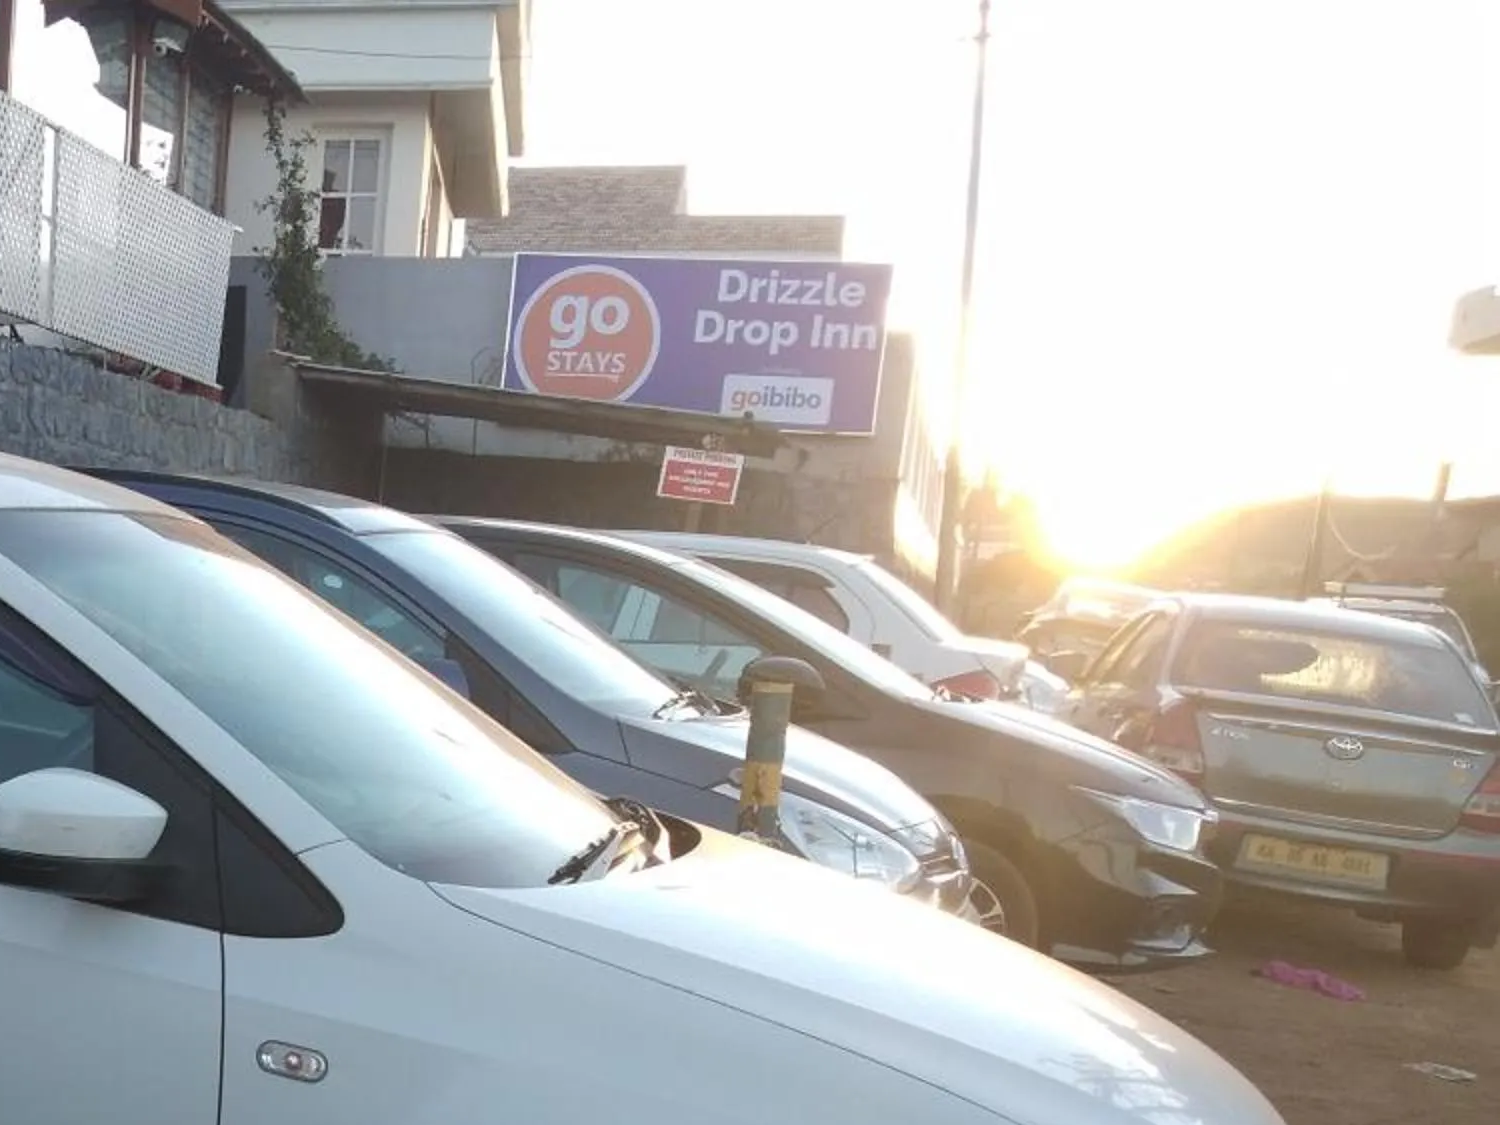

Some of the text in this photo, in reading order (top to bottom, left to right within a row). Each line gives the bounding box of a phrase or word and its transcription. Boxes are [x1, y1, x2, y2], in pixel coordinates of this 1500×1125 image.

[717, 269, 866, 307] Drizzle
[550, 295, 630, 349] go
[694, 309, 877, 355] Drop Inn
[547, 351, 626, 373] STAYS
[731, 385, 822, 410] goibibo
